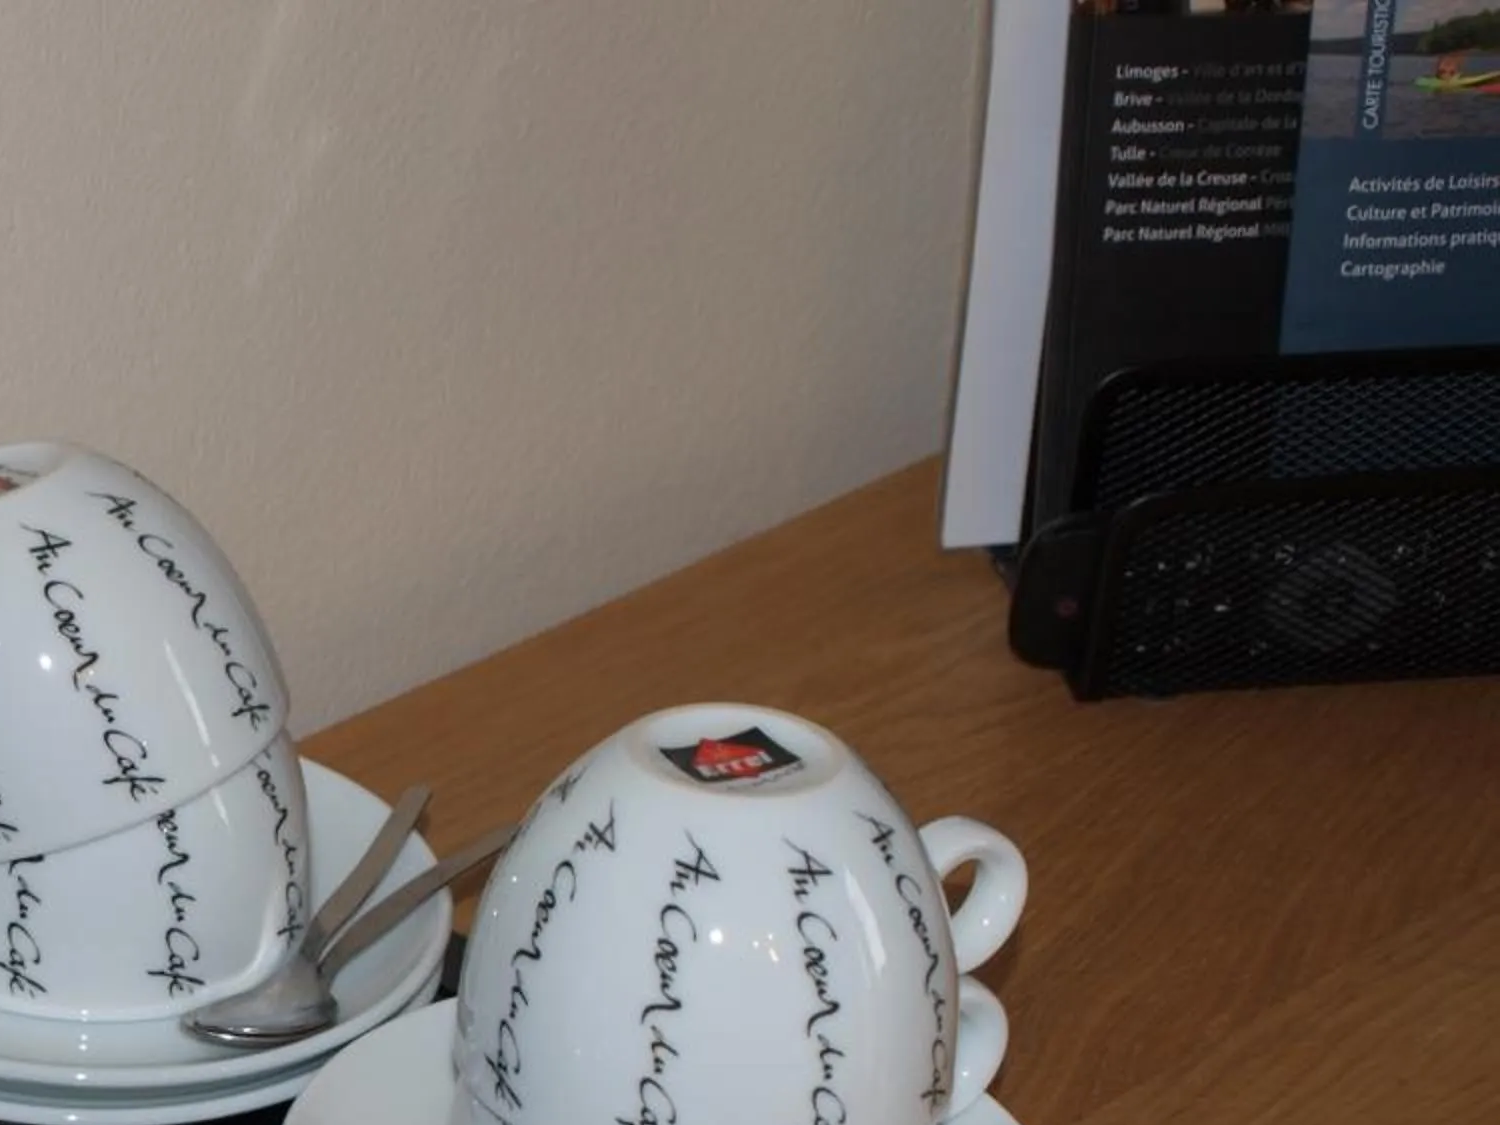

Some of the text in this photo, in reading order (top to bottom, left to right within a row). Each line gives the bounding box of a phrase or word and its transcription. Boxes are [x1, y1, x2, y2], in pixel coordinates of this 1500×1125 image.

[1116, 63, 1181, 83] Limoges
[1113, 90, 1154, 107] Brive
[1362, 80, 1383, 129] CARTE
[1110, 117, 1186, 134] Aubusson
[1110, 144, 1147, 161] Tulle
[1107, 171, 1155, 188] Vallée
[1157, 170, 1177, 187] de
[1180, 170, 1194, 186] la
[1197, 169, 1248, 186] Creuse
[1348, 171, 1500, 193] Activités de Loisirs
[1103, 200, 1138, 216] Parc
[1140, 198, 1196, 215] Naturel
[1197, 195, 1262, 217] Régional
[1346, 203, 1407, 221] Culture
[1410, 204, 1428, 220] et
[1101, 226, 1135, 243] Parc
[1137, 223, 1193, 241] Naturel
[1195, 221, 1259, 243] Régional
[1343, 231, 1447, 249] Informations
[1340, 260, 1446, 280] Cartographie
